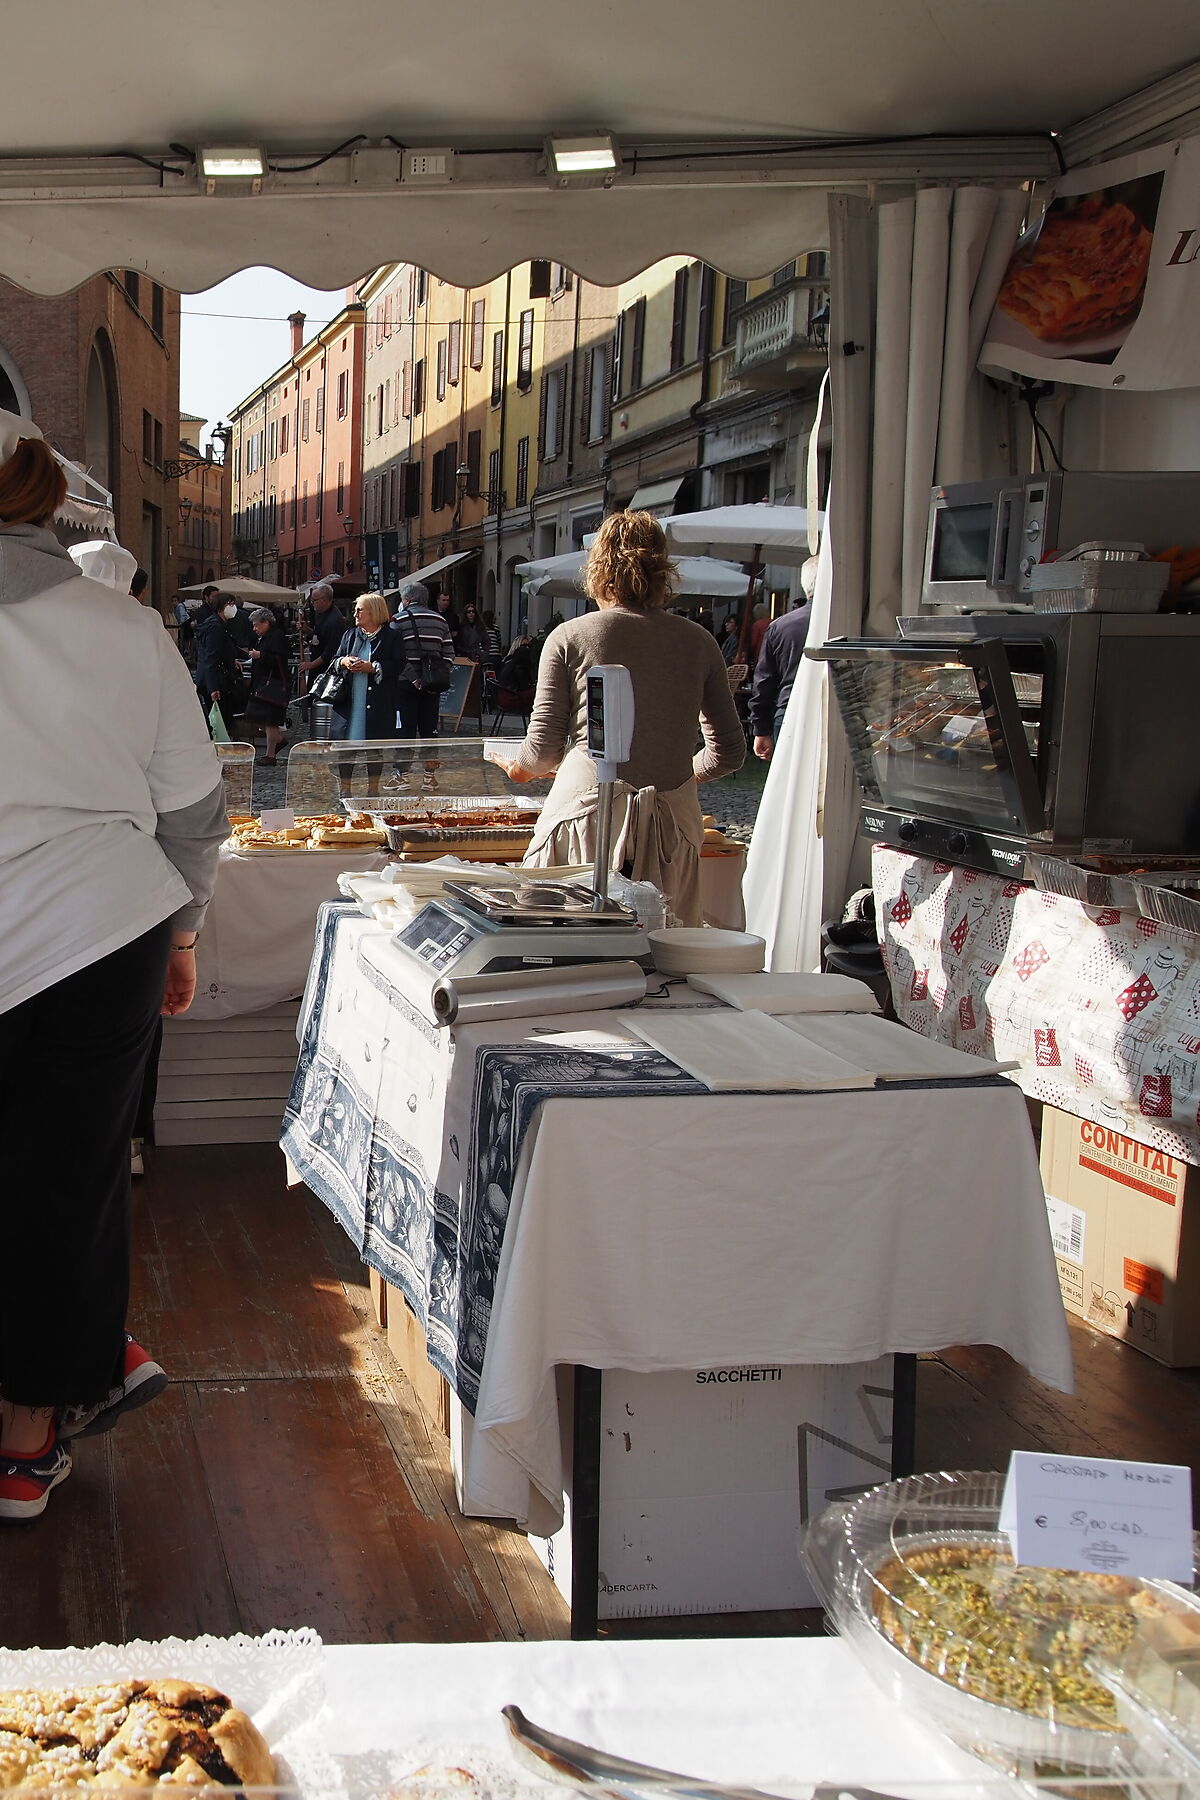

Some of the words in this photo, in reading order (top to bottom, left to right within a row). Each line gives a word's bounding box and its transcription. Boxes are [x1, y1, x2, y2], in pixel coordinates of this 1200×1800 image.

[1080, 1120, 1178, 1180] CONTITAL
[1081, 1145, 1113, 1167] CONTENITORI
[1117, 1161, 1137, 1174] ROTOLI
[1137, 1167, 1149, 1180] PER
[1149, 1171, 1176, 1190] ALIMENTI
[696, 1368, 782, 1384] SACCHETTI
[1036, 1515, 1048, 1528] €
[599, 1583, 658, 1593] ADERCARTA
